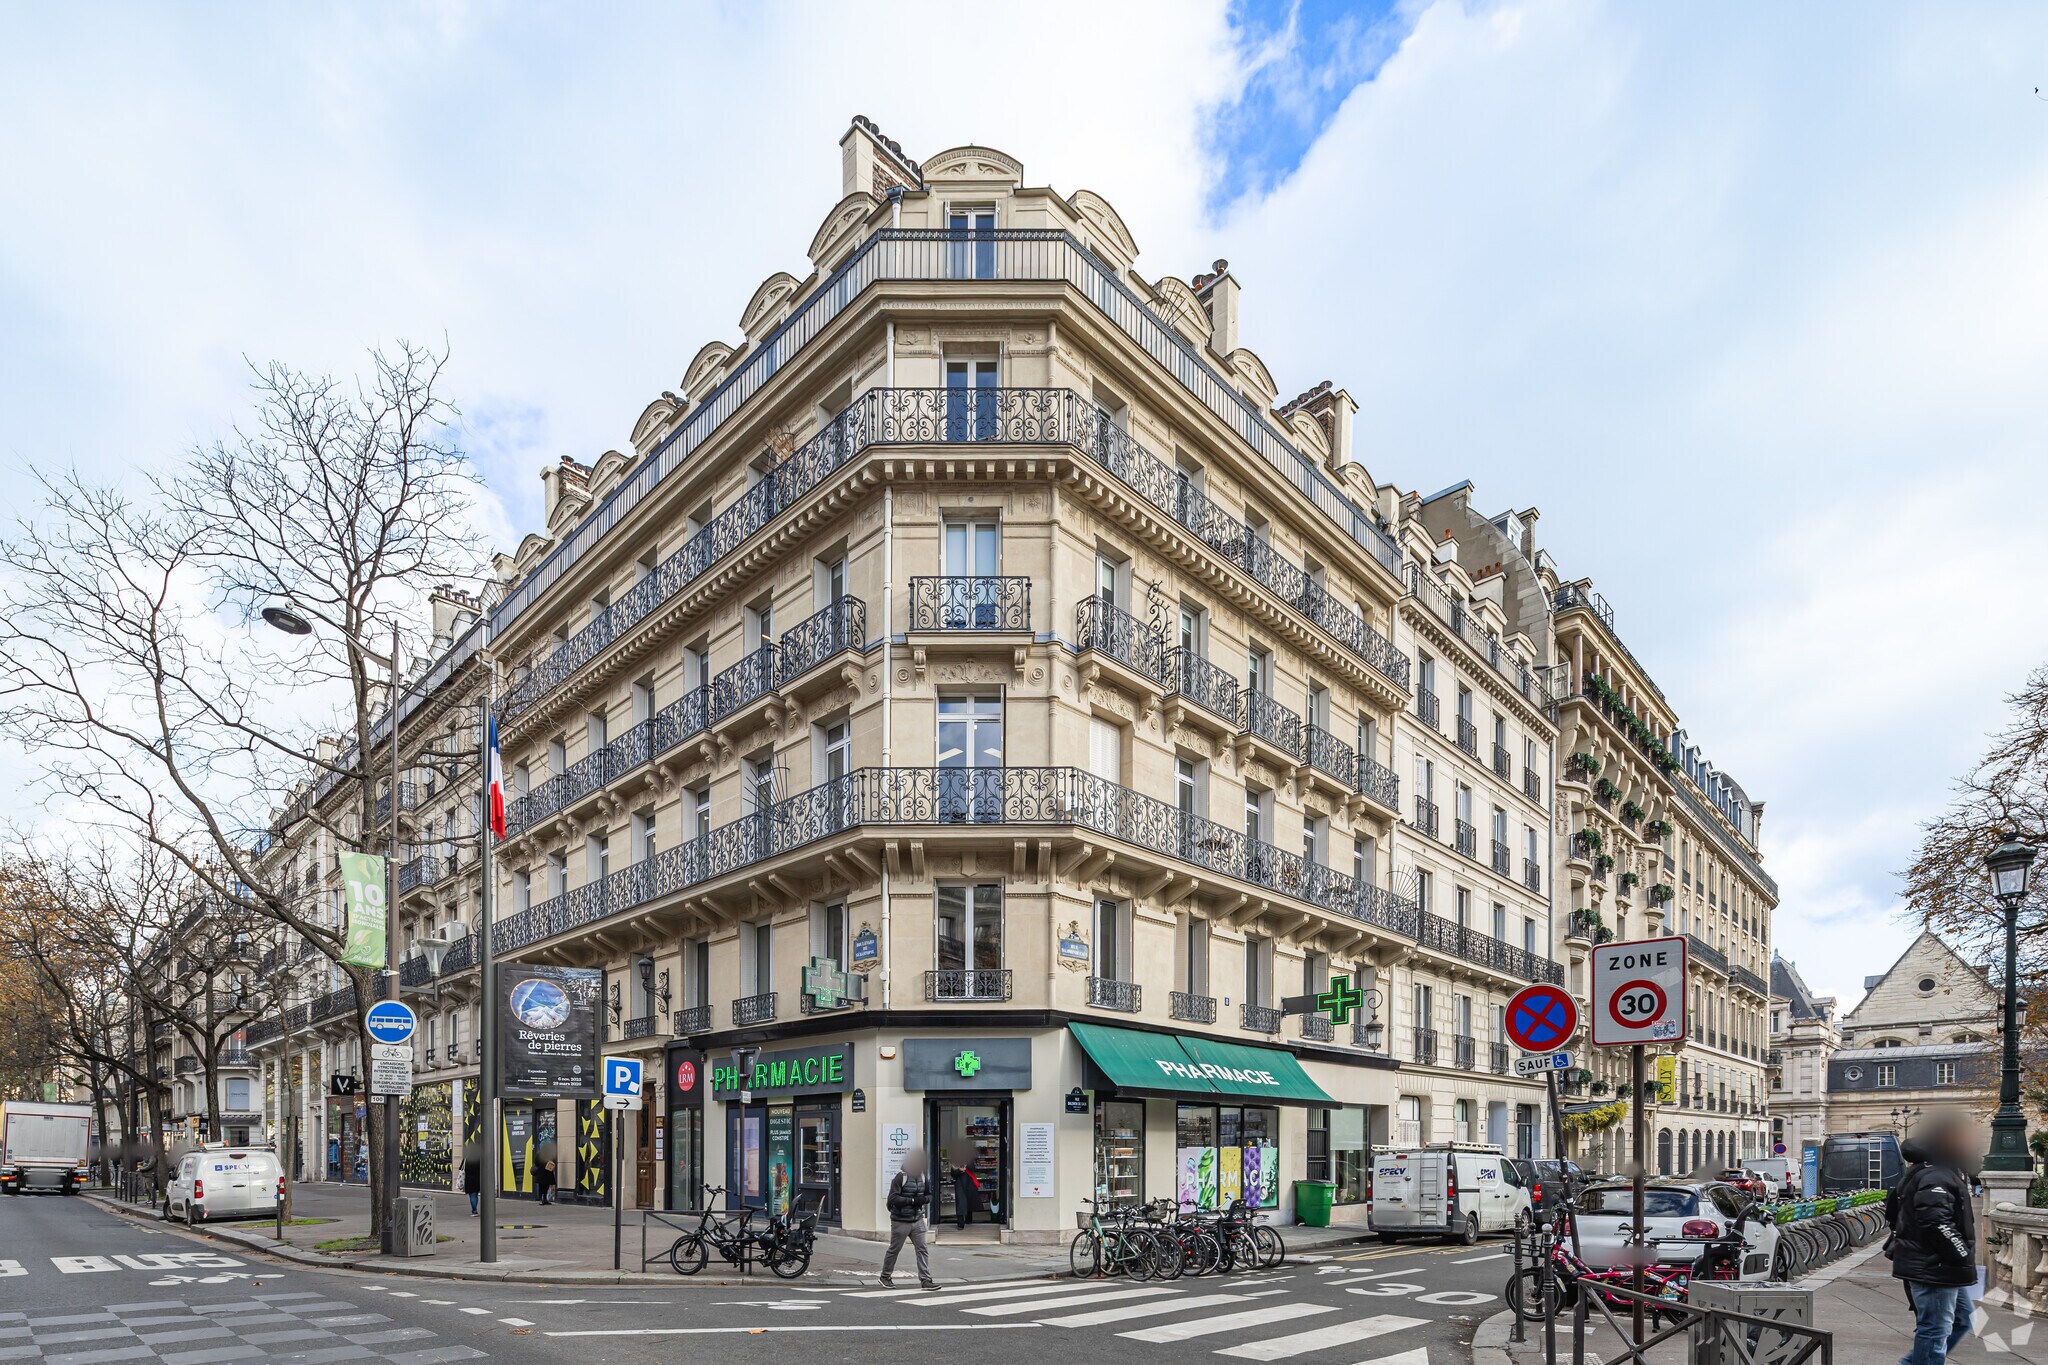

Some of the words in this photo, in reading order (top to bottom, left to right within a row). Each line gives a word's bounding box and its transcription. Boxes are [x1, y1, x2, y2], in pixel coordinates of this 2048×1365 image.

[349, 880, 384, 907] 10
[353, 903, 384, 918] ANS
[1609, 952, 1667, 970] ZONE
[1620, 993, 1655, 1015] 30
[519, 1030, 565, 1041] Rêveries
[528, 1040, 541, 1049] de
[544, 1041, 582, 1052] pierres
[714, 1055, 843, 1091] PHRMACIE
[1155, 1060, 1280, 1085] PHARMACIE
[1518, 1057, 1551, 1071] SAUF
[615, 1066, 631, 1088] P
[679, 1073, 694, 1084] LRM
[1660, 1069, 1671, 1099] SOLLY
[1480, 1169, 1496, 1179] SPECV
[50, 1253, 247, 1273] BUS
[1345, 1283, 1498, 1305] 30
